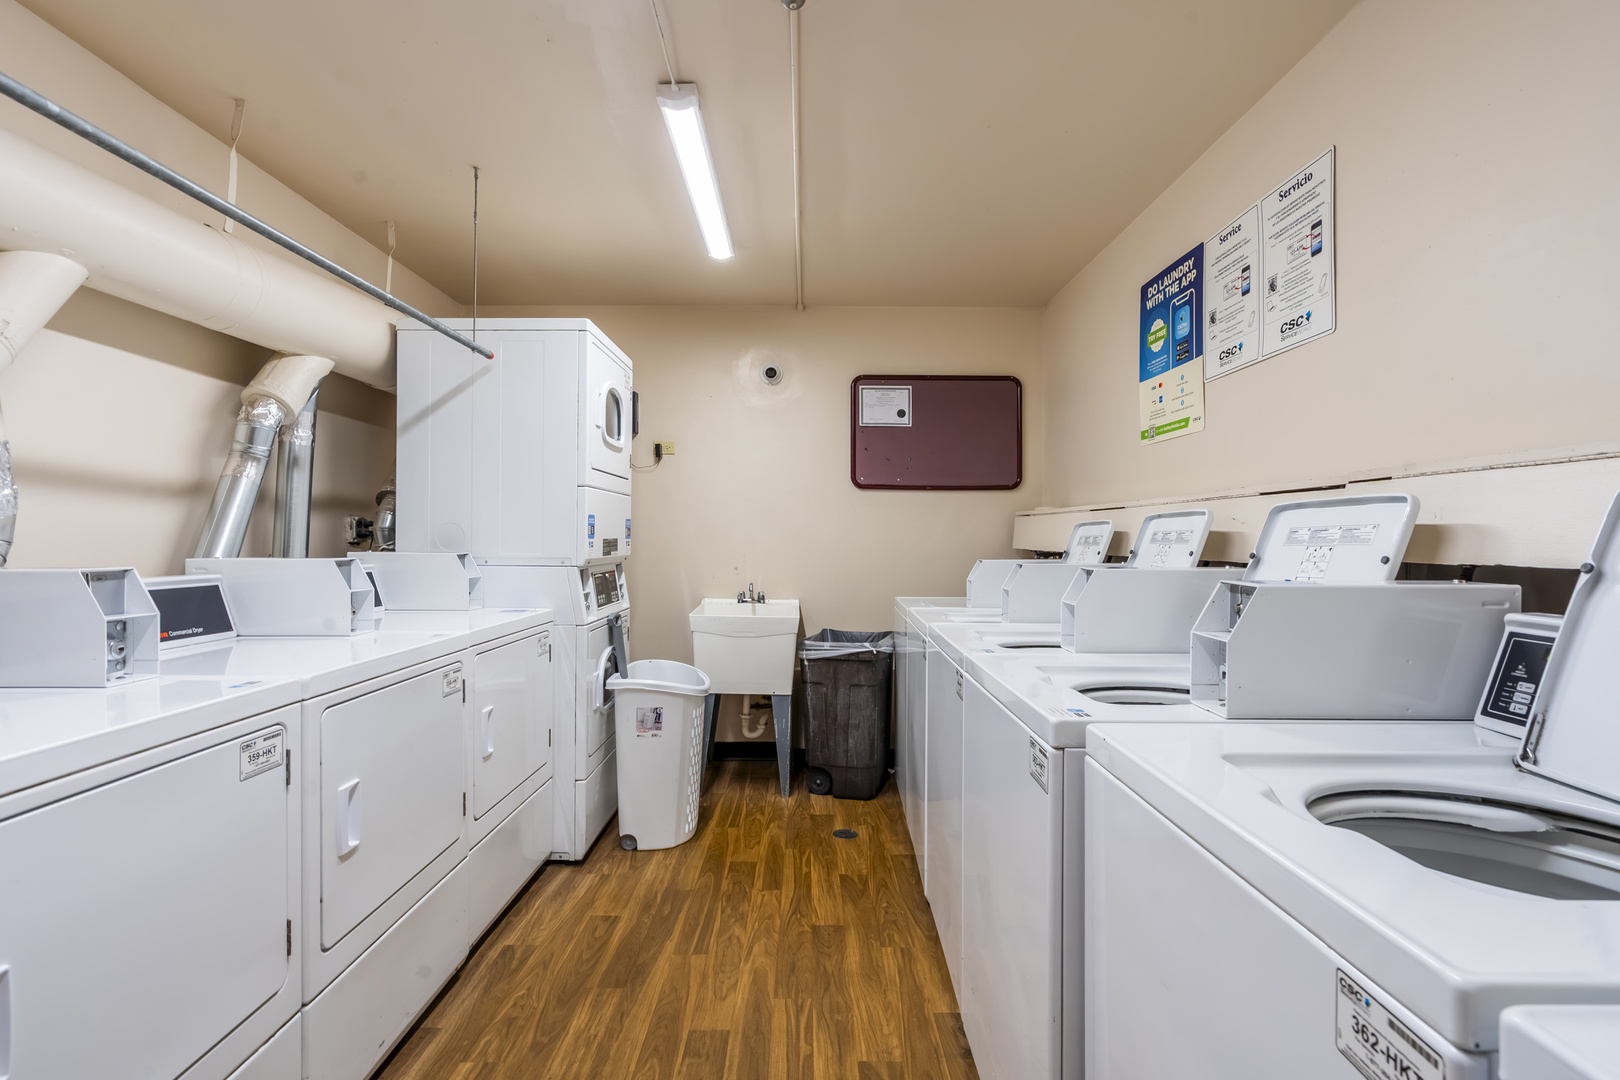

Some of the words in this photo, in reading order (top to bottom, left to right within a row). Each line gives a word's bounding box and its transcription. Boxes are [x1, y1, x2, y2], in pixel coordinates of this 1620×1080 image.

[1278, 172, 1313, 202] Servicio
[1219, 223, 1242, 245] Service
[1147, 283, 1158, 298] DO
[1159, 256, 1195, 290] LAUNDRY
[1145, 291, 1164, 310] WITH
[1165, 280, 1180, 298] THE
[1181, 269, 1197, 289] APP
[1156, 327, 1167, 339] FREE
[1280, 315, 1304, 334] CSC
[1219, 345, 1238, 361] CSC
[168, 628, 192, 637] Commercial
[192, 627, 204, 635] Dryer
[242, 742, 254, 751] CSC
[247, 745, 277, 764] 359-HKT
[1339, 977, 1363, 1002] CSC
